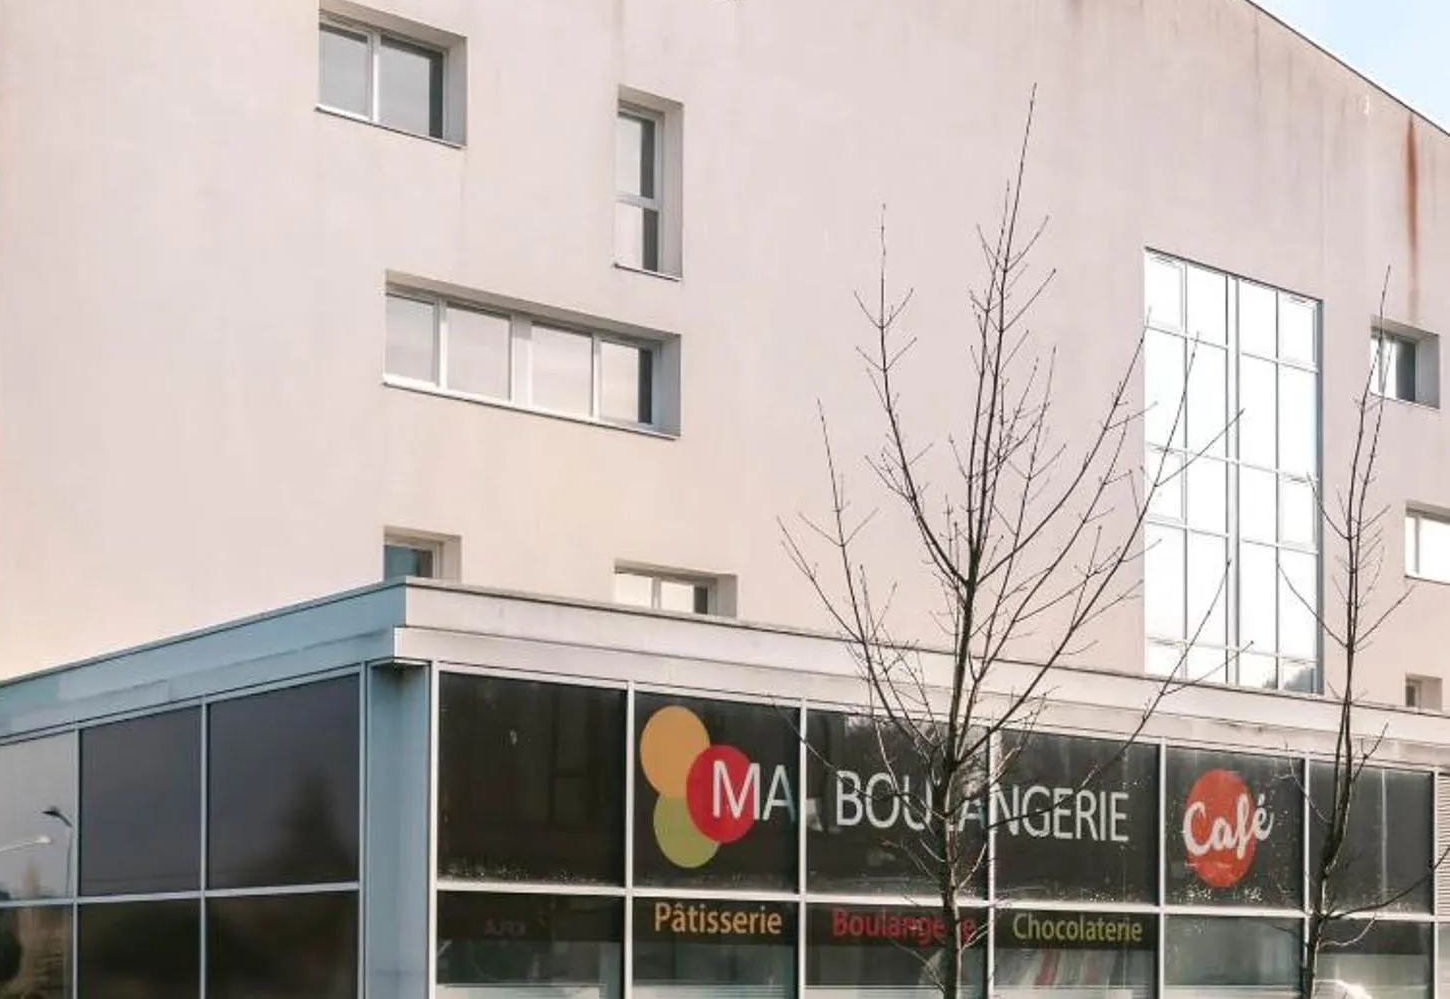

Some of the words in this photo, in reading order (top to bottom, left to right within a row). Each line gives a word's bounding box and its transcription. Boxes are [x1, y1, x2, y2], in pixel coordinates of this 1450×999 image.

[712, 760, 797, 823] MA
[1183, 793, 1274, 859] Café
[655, 901, 782, 936] Pâtisserie
[832, 906, 978, 945] Boulangee
[1013, 912, 1144, 943] Chocolaterie
